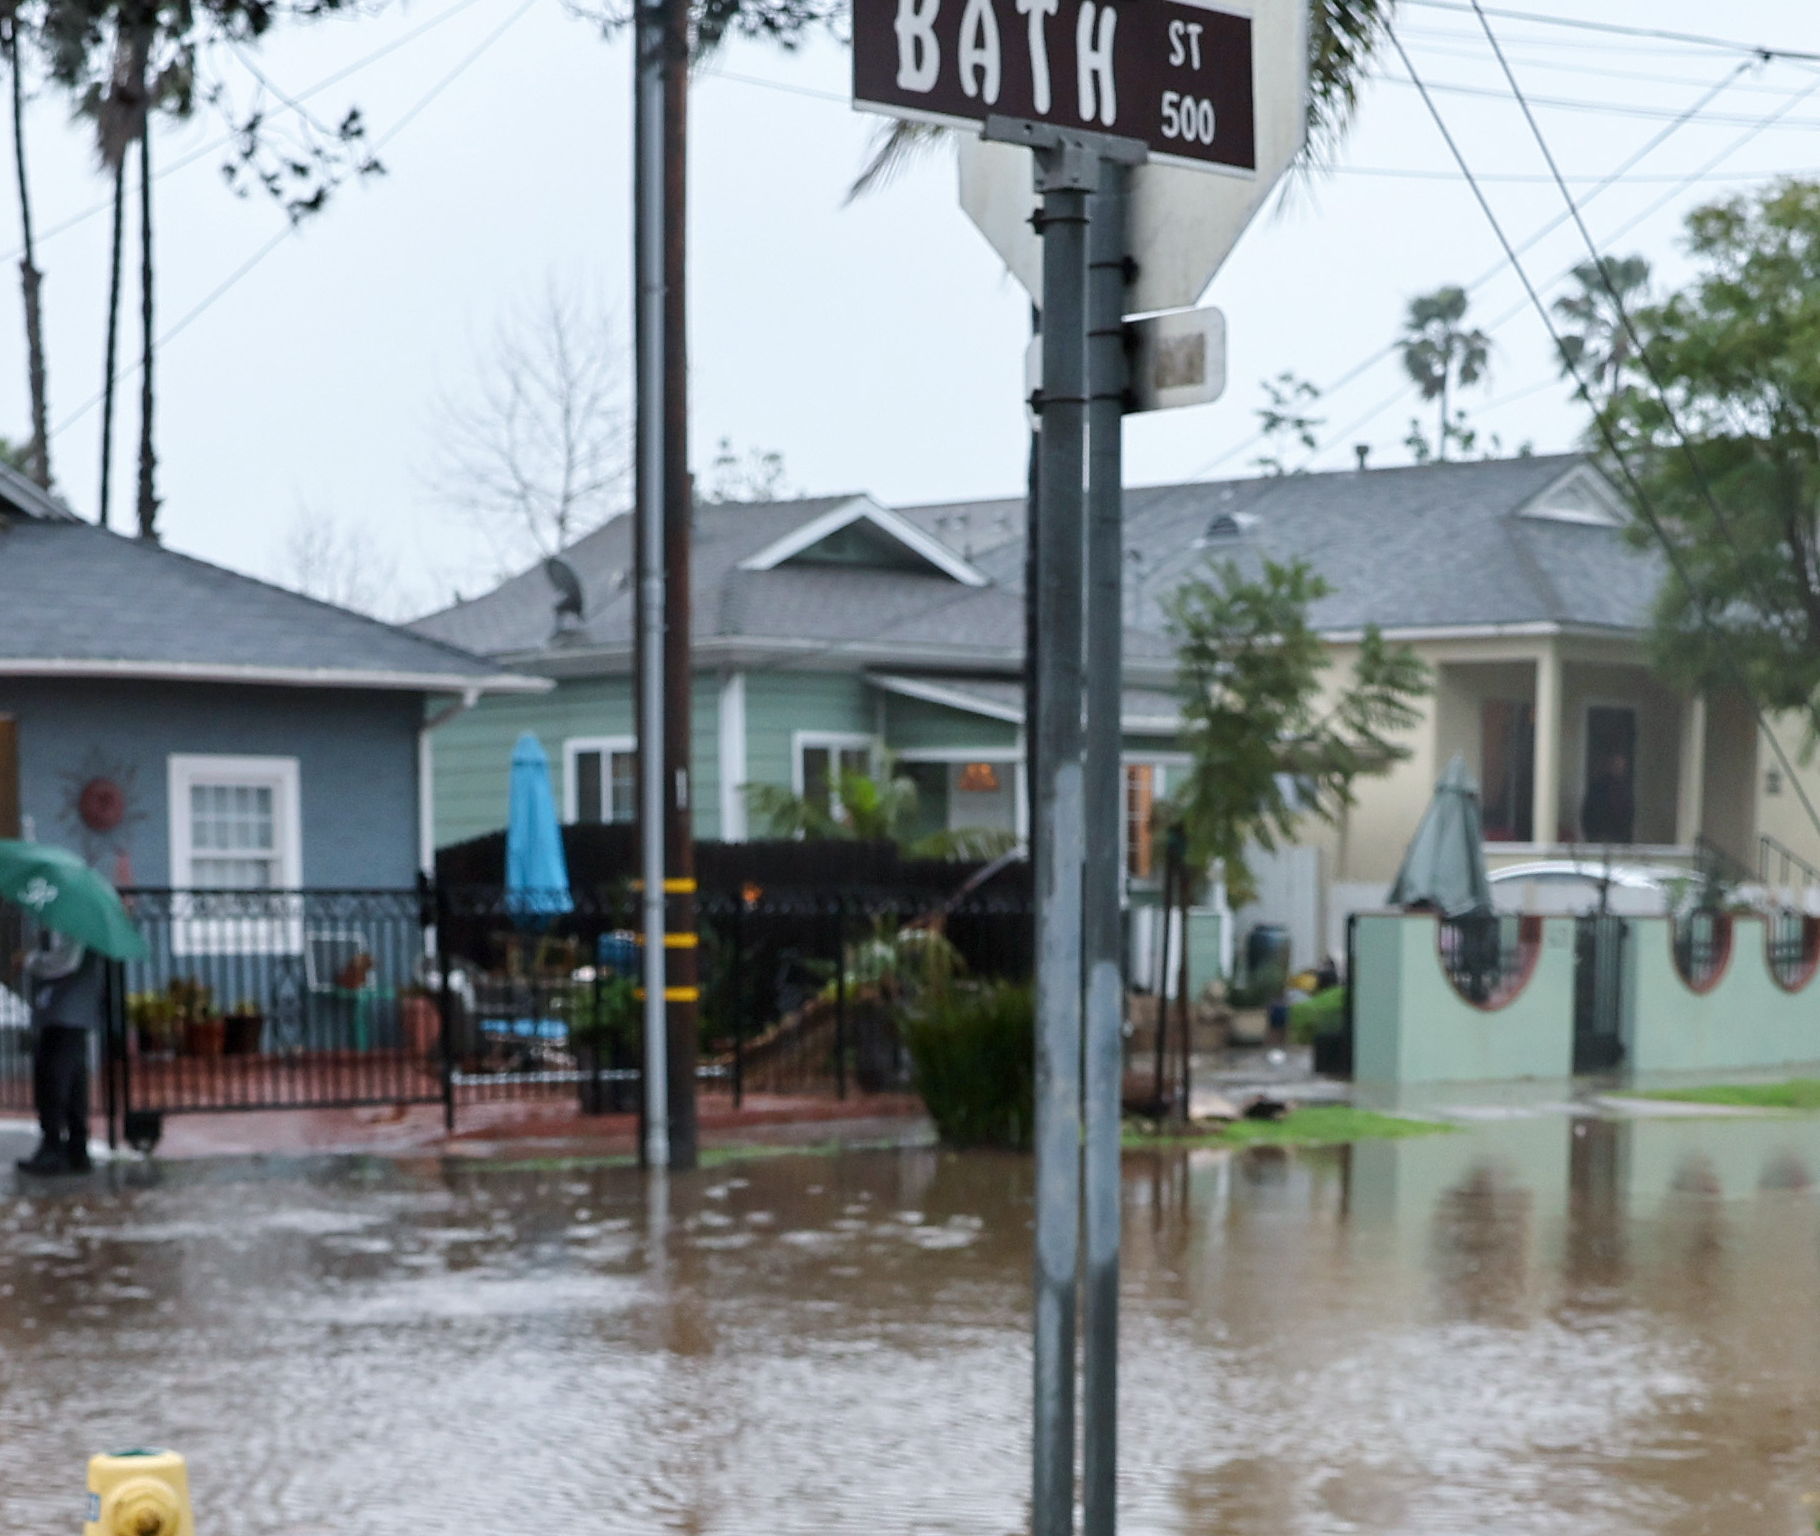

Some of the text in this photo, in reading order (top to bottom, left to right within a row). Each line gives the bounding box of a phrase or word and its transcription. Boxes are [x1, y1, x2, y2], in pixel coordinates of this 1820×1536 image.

[894, 0, 1204, 127] BATH ST
[1160, 90, 1216, 146] 500
